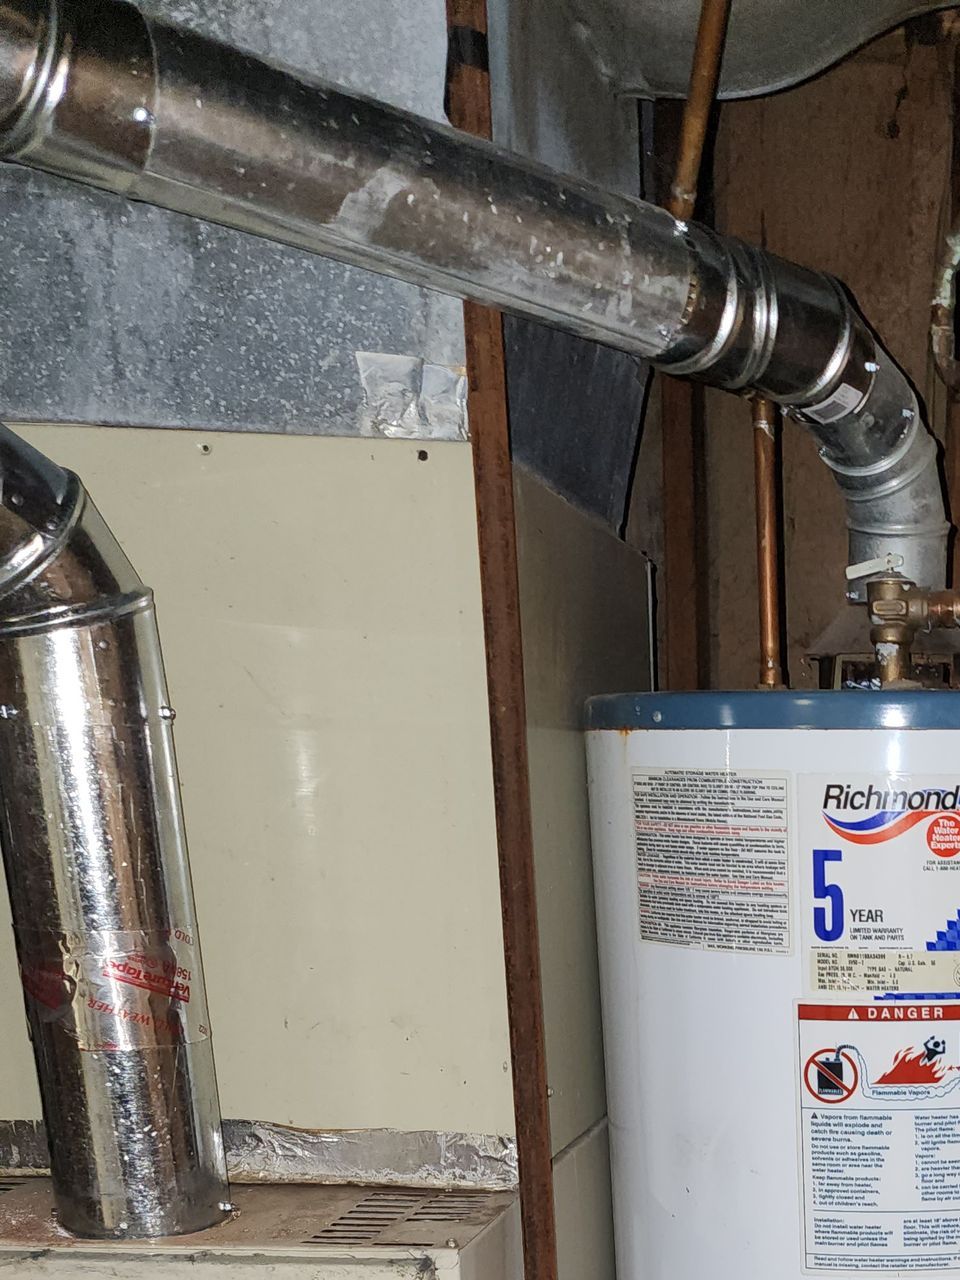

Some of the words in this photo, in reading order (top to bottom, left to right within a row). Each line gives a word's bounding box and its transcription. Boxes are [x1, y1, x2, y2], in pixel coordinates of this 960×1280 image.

[823, 785, 960, 810] Richmond
[813, 849, 844, 941] 5
[850, 909, 883, 922] YEAR
[868, 1007, 943, 1019] DANGER
